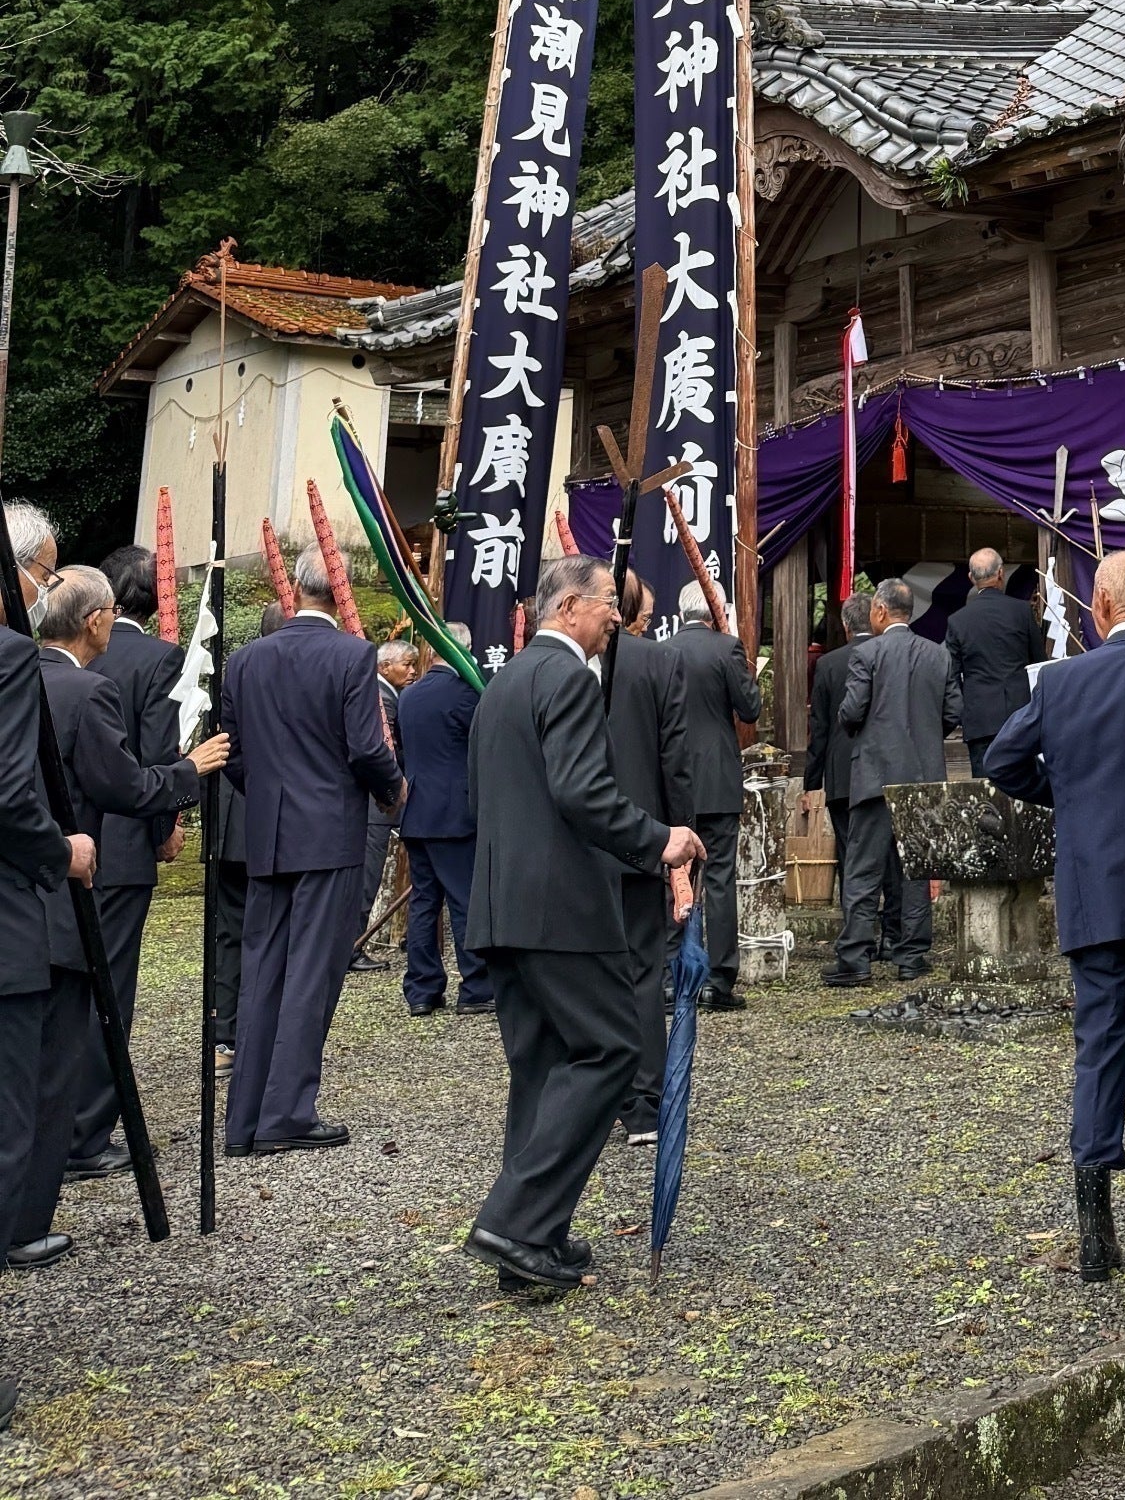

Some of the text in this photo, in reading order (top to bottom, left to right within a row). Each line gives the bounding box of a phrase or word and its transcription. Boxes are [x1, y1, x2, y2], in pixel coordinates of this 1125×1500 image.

[468, 2, 584, 592] 潮見神社大廣前
